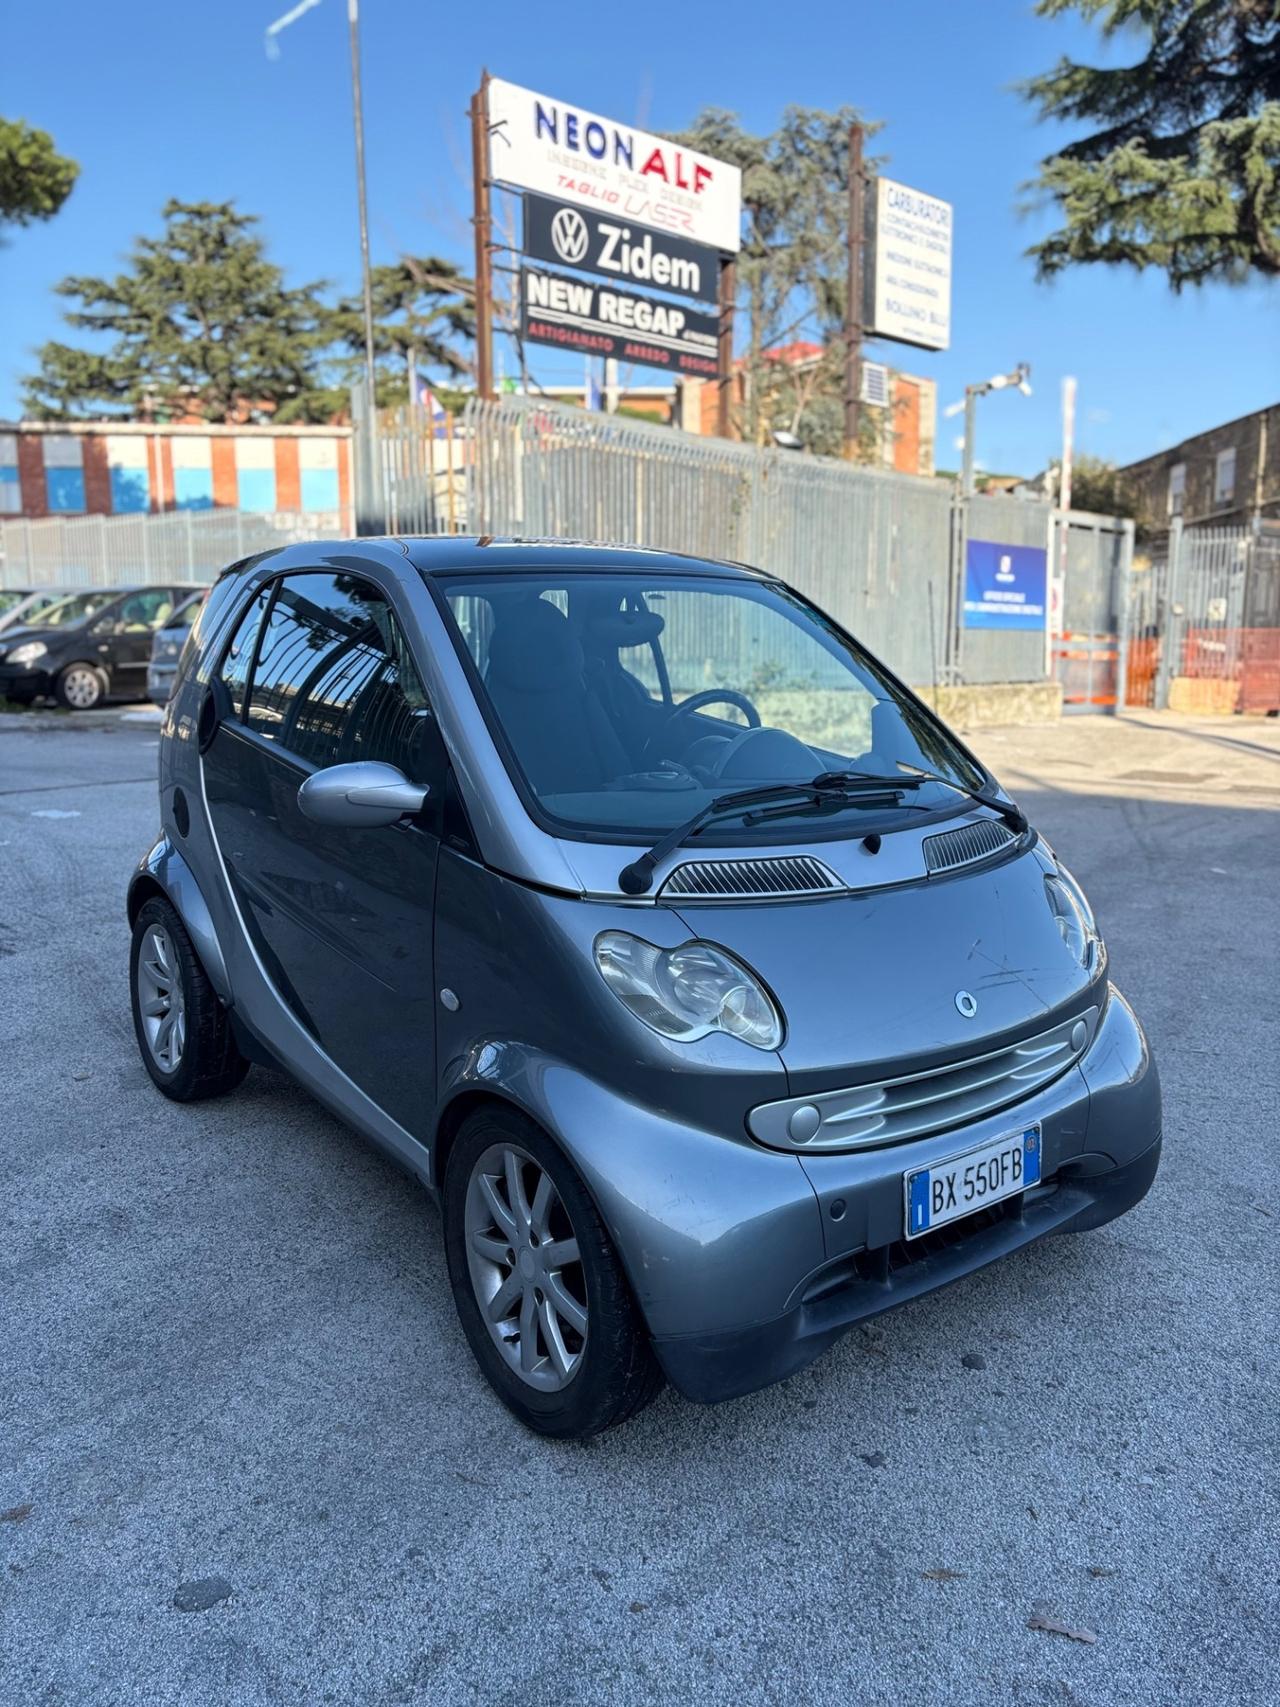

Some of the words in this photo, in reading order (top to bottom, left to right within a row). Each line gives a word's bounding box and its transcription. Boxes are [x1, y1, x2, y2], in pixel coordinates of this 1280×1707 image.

[558, 174, 620, 204] TAGLIO
[596, 222, 700, 293] Zidem
[526, 272, 594, 317] NEW
[599, 291, 686, 338] REGAP
[528, 322, 614, 352] ARTIGIANATO
[624, 343, 670, 364] ARREDO
[932, 1173, 957, 1215] BX
[963, 1147, 1023, 1201] 550FB
